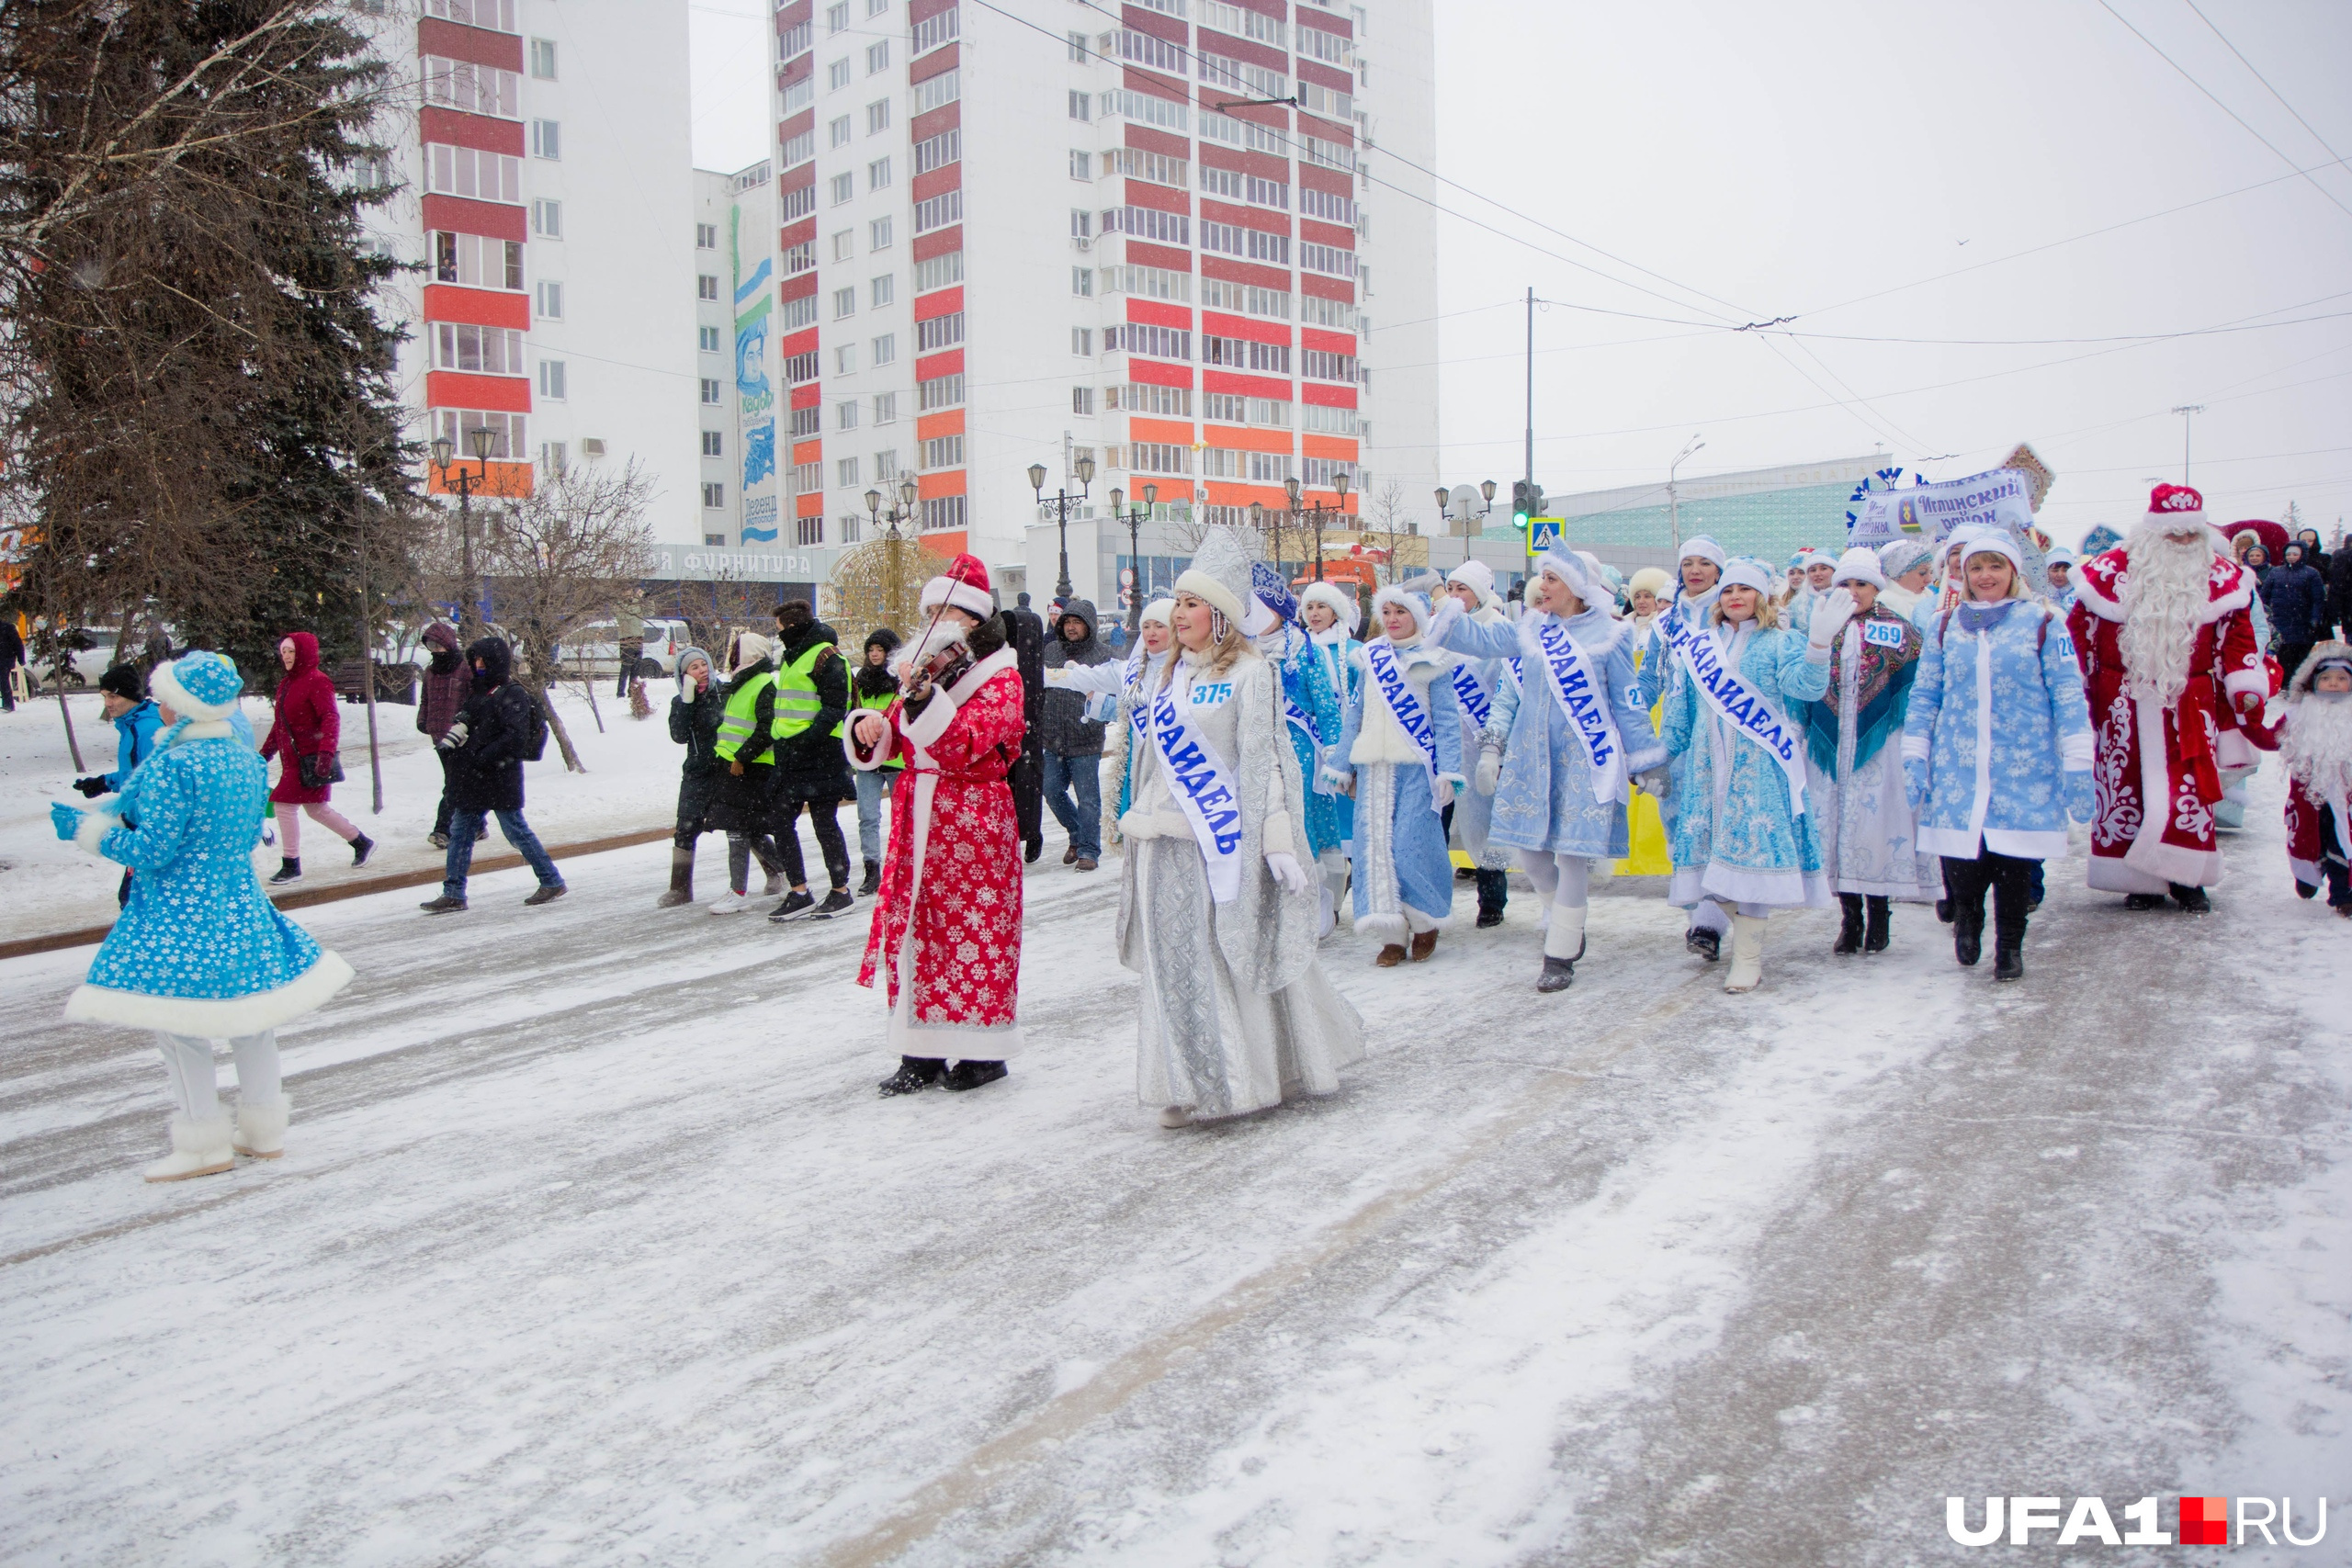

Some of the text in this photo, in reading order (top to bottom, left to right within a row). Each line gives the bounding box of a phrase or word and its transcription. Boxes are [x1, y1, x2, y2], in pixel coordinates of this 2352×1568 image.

[1917, 478, 2020, 513] Иглинский
[684, 553, 810, 574] ФУРНИТУРА
[1867, 624, 1901, 644] 269
[1192, 682, 1232, 705] 375
[1688, 632, 1793, 761] КАРАИДЕЛЬ
